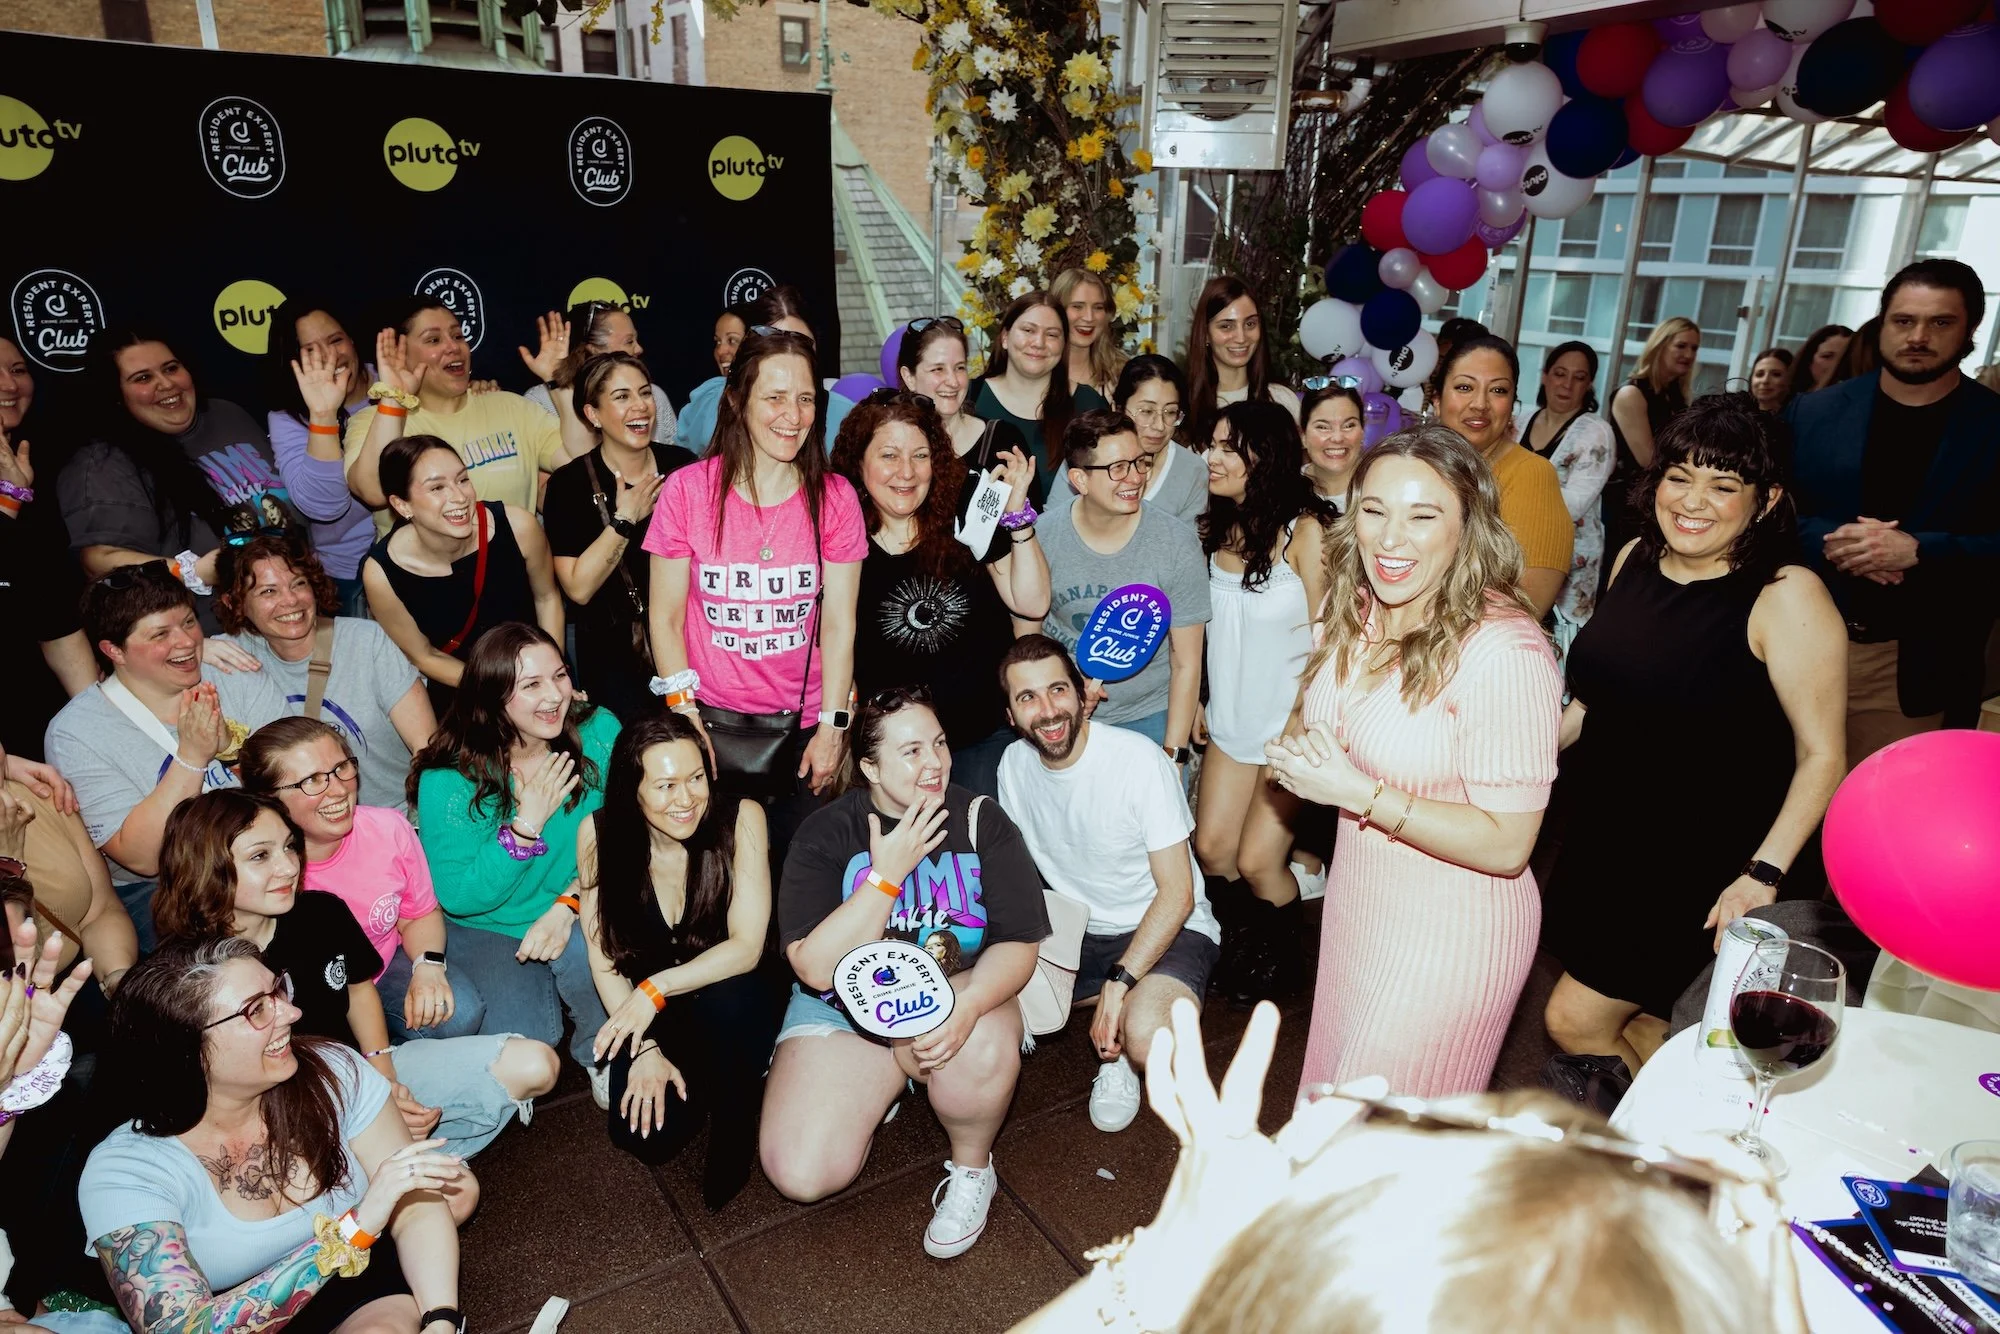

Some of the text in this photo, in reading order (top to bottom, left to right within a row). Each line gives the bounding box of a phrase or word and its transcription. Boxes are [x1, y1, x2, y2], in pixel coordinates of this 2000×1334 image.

[52, 118, 83, 140] tv
[209, 106, 275, 154] RESIDENT EXPERT
[388, 138, 481, 167] pluto tv
[575, 125, 625, 168] RESIDENT EXPERT
[221, 153, 270, 177] Club
[583, 166, 620, 188] Club
[711, 153, 785, 179] pluto tv
[22, 280, 95, 328] RESIDENT EXPERT
[452, 279, 477, 318] EXPERT
[630, 293, 651, 309] tv
[37, 327, 90, 352] Club
[981, 493, 1000, 509] BODY
[983, 486, 1001, 502] FULL
[976, 499, 999, 518] CHILLS
[703, 570, 812, 595] TRUE
[706, 602, 810, 625] CRIME
[1093, 592, 1163, 647] RESIDENT EXPERT
[1106, 627, 1141, 641] CRIME JUNKIE
[1089, 635, 1138, 664] Club
[846, 951, 936, 1008] RESIDENT EXPERT
[872, 982, 917, 999] CRIME JUNKIE
[875, 990, 935, 1023] Club
